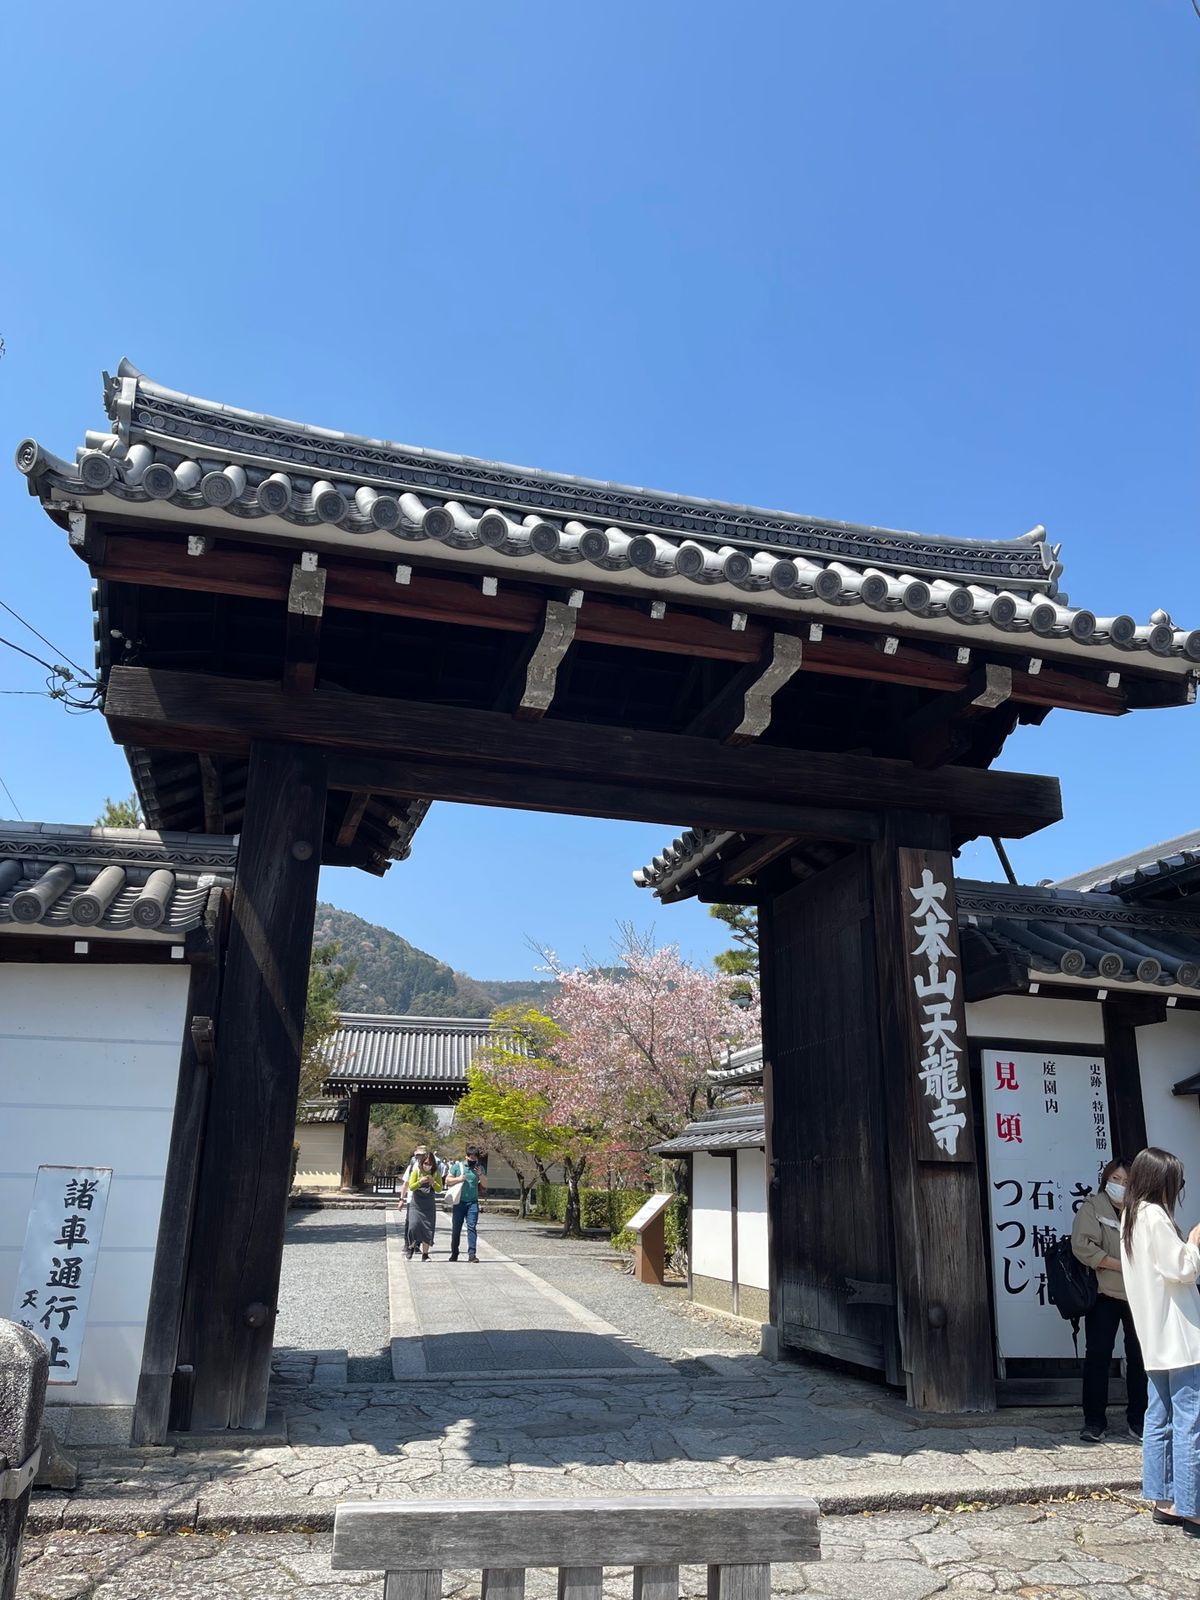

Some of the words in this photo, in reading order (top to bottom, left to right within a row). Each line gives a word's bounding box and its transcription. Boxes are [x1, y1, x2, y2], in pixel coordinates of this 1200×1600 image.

[909, 868, 967, 1156] 大本山天龍寺
[994, 1061, 1023, 1143] 見頃
[1043, 1061, 1058, 1113] 庭園内
[1089, 1064, 1108, 1150] 史跡・特別名勝
[993, 1180, 1030, 1294] つつじ
